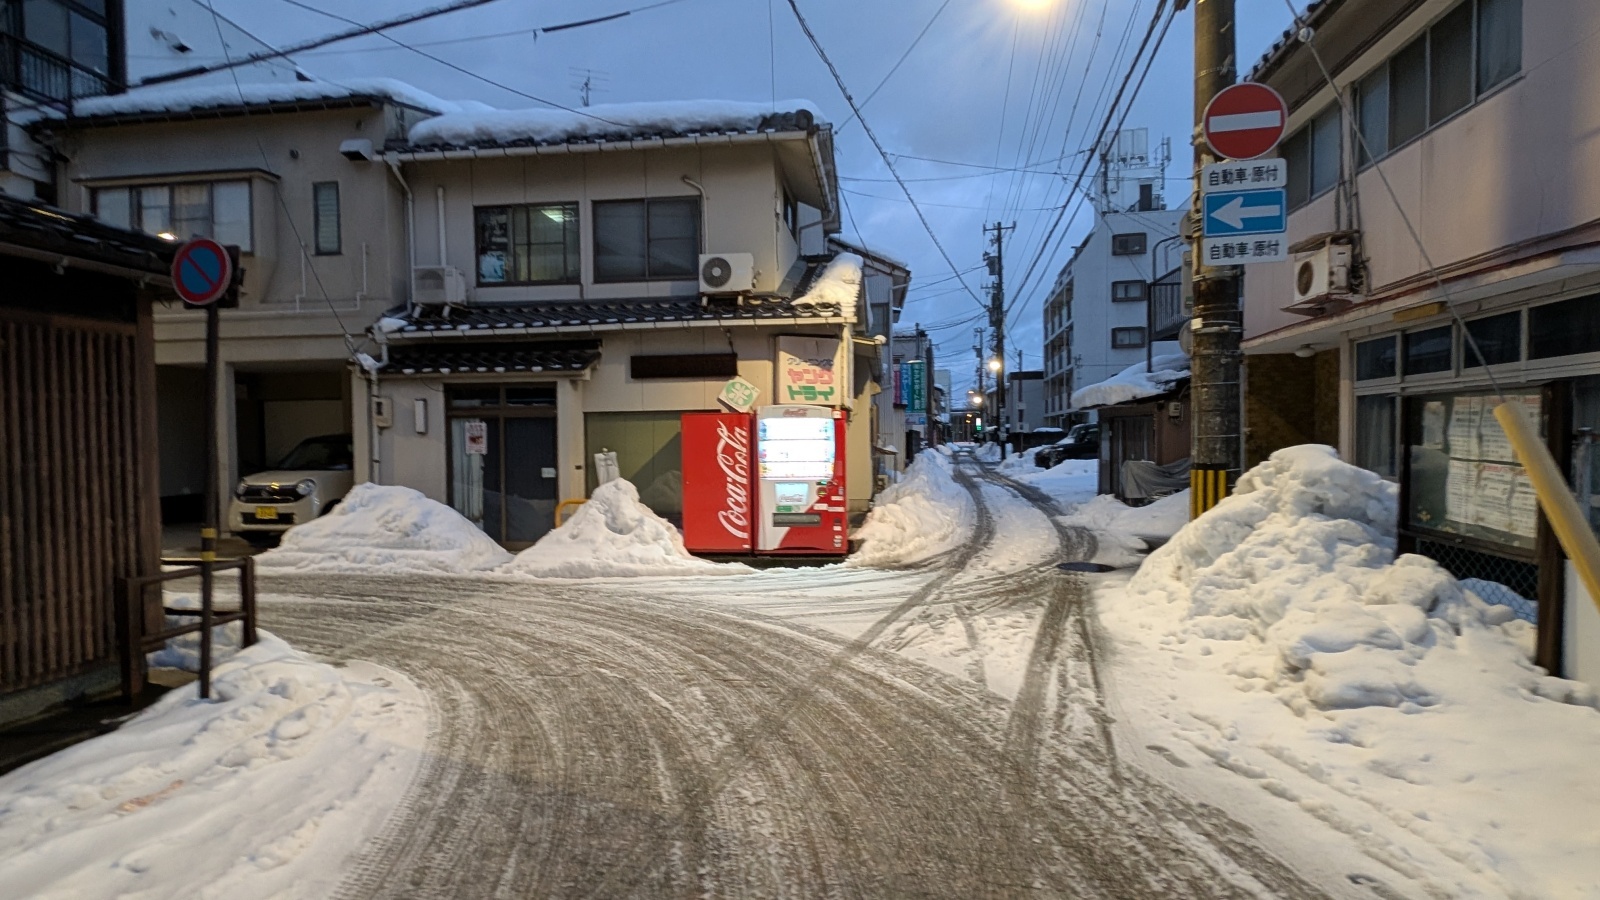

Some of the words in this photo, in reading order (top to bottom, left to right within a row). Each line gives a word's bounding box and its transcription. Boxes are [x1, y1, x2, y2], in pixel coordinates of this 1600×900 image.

[786, 368, 834, 385] ヤング
[786, 385, 835, 401] トライ
[716, 418, 748, 539] Coca-Cola
